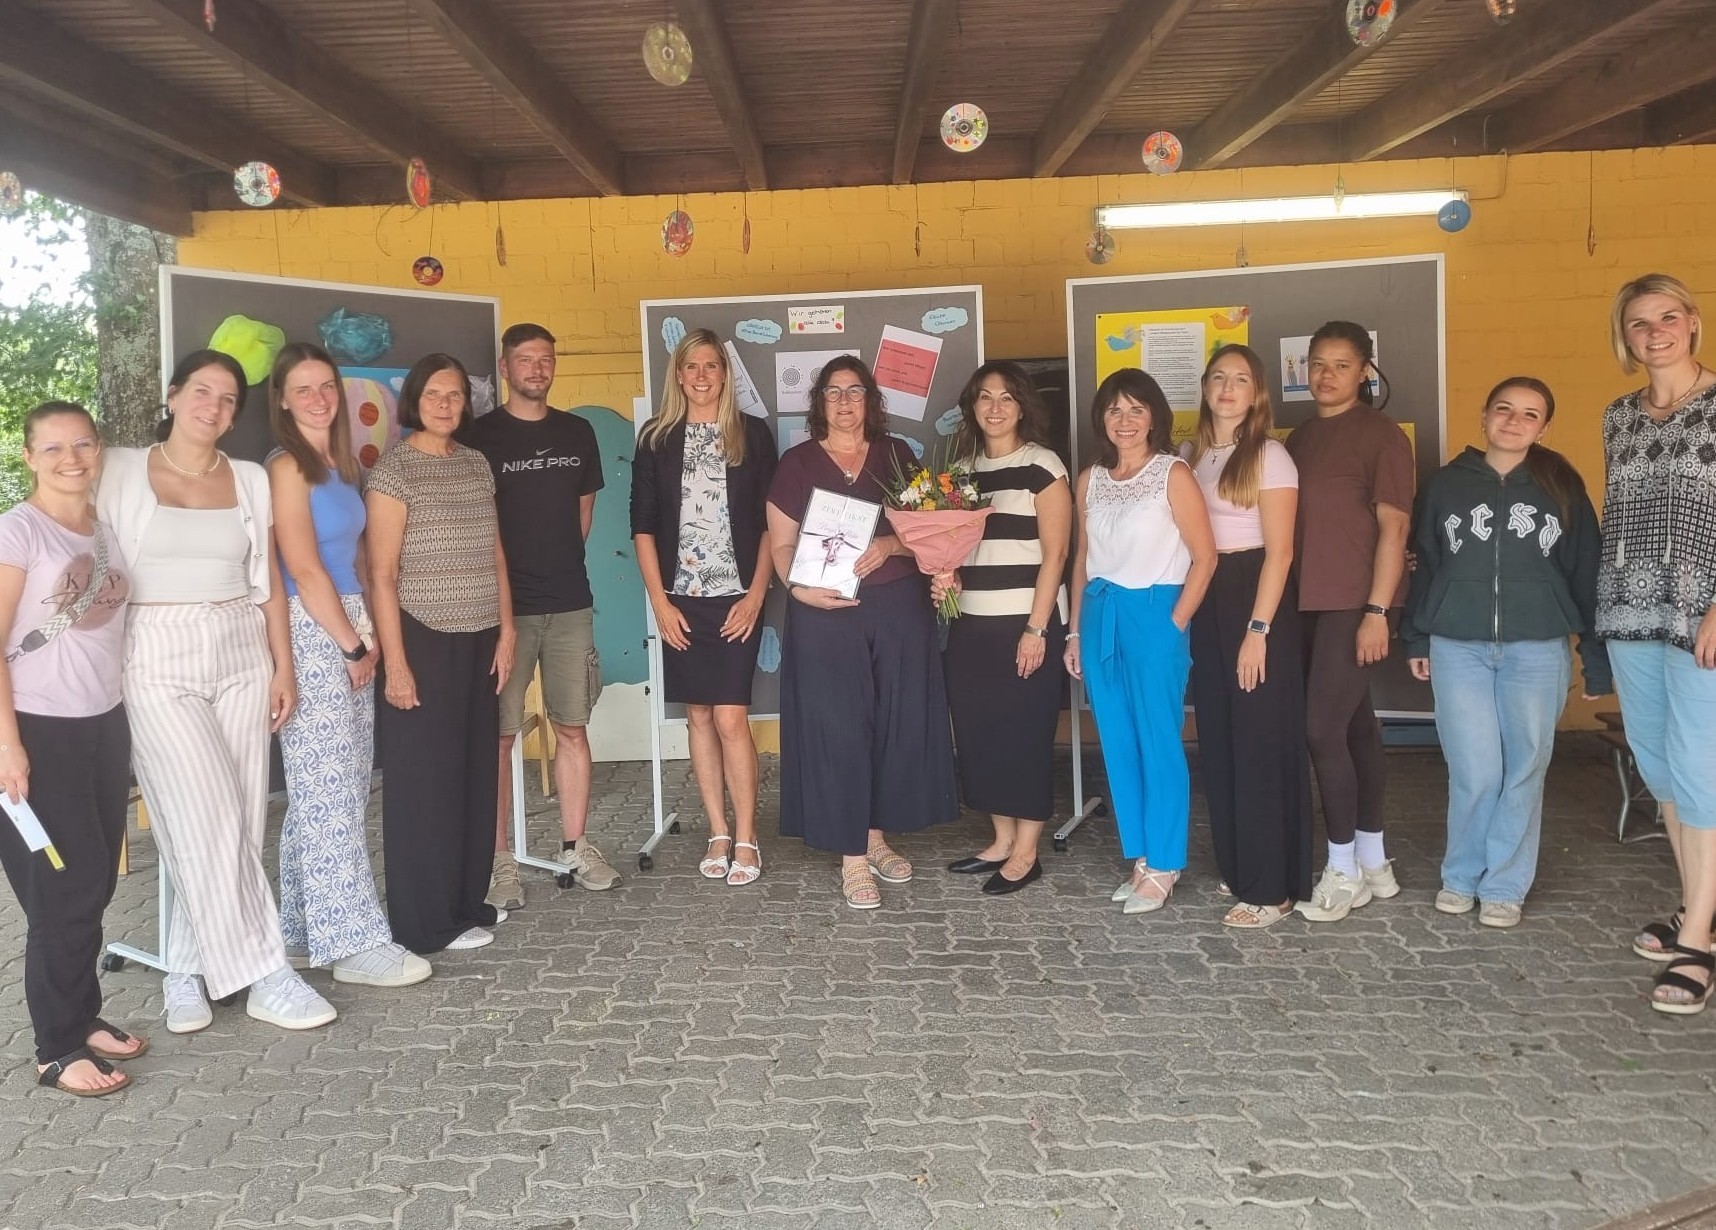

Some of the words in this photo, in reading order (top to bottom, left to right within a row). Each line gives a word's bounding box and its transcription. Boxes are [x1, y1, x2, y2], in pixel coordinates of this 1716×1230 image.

[502, 459, 544, 473] NIKE
[546, 456, 581, 468] PRO
[65, 572, 121, 591] KP
